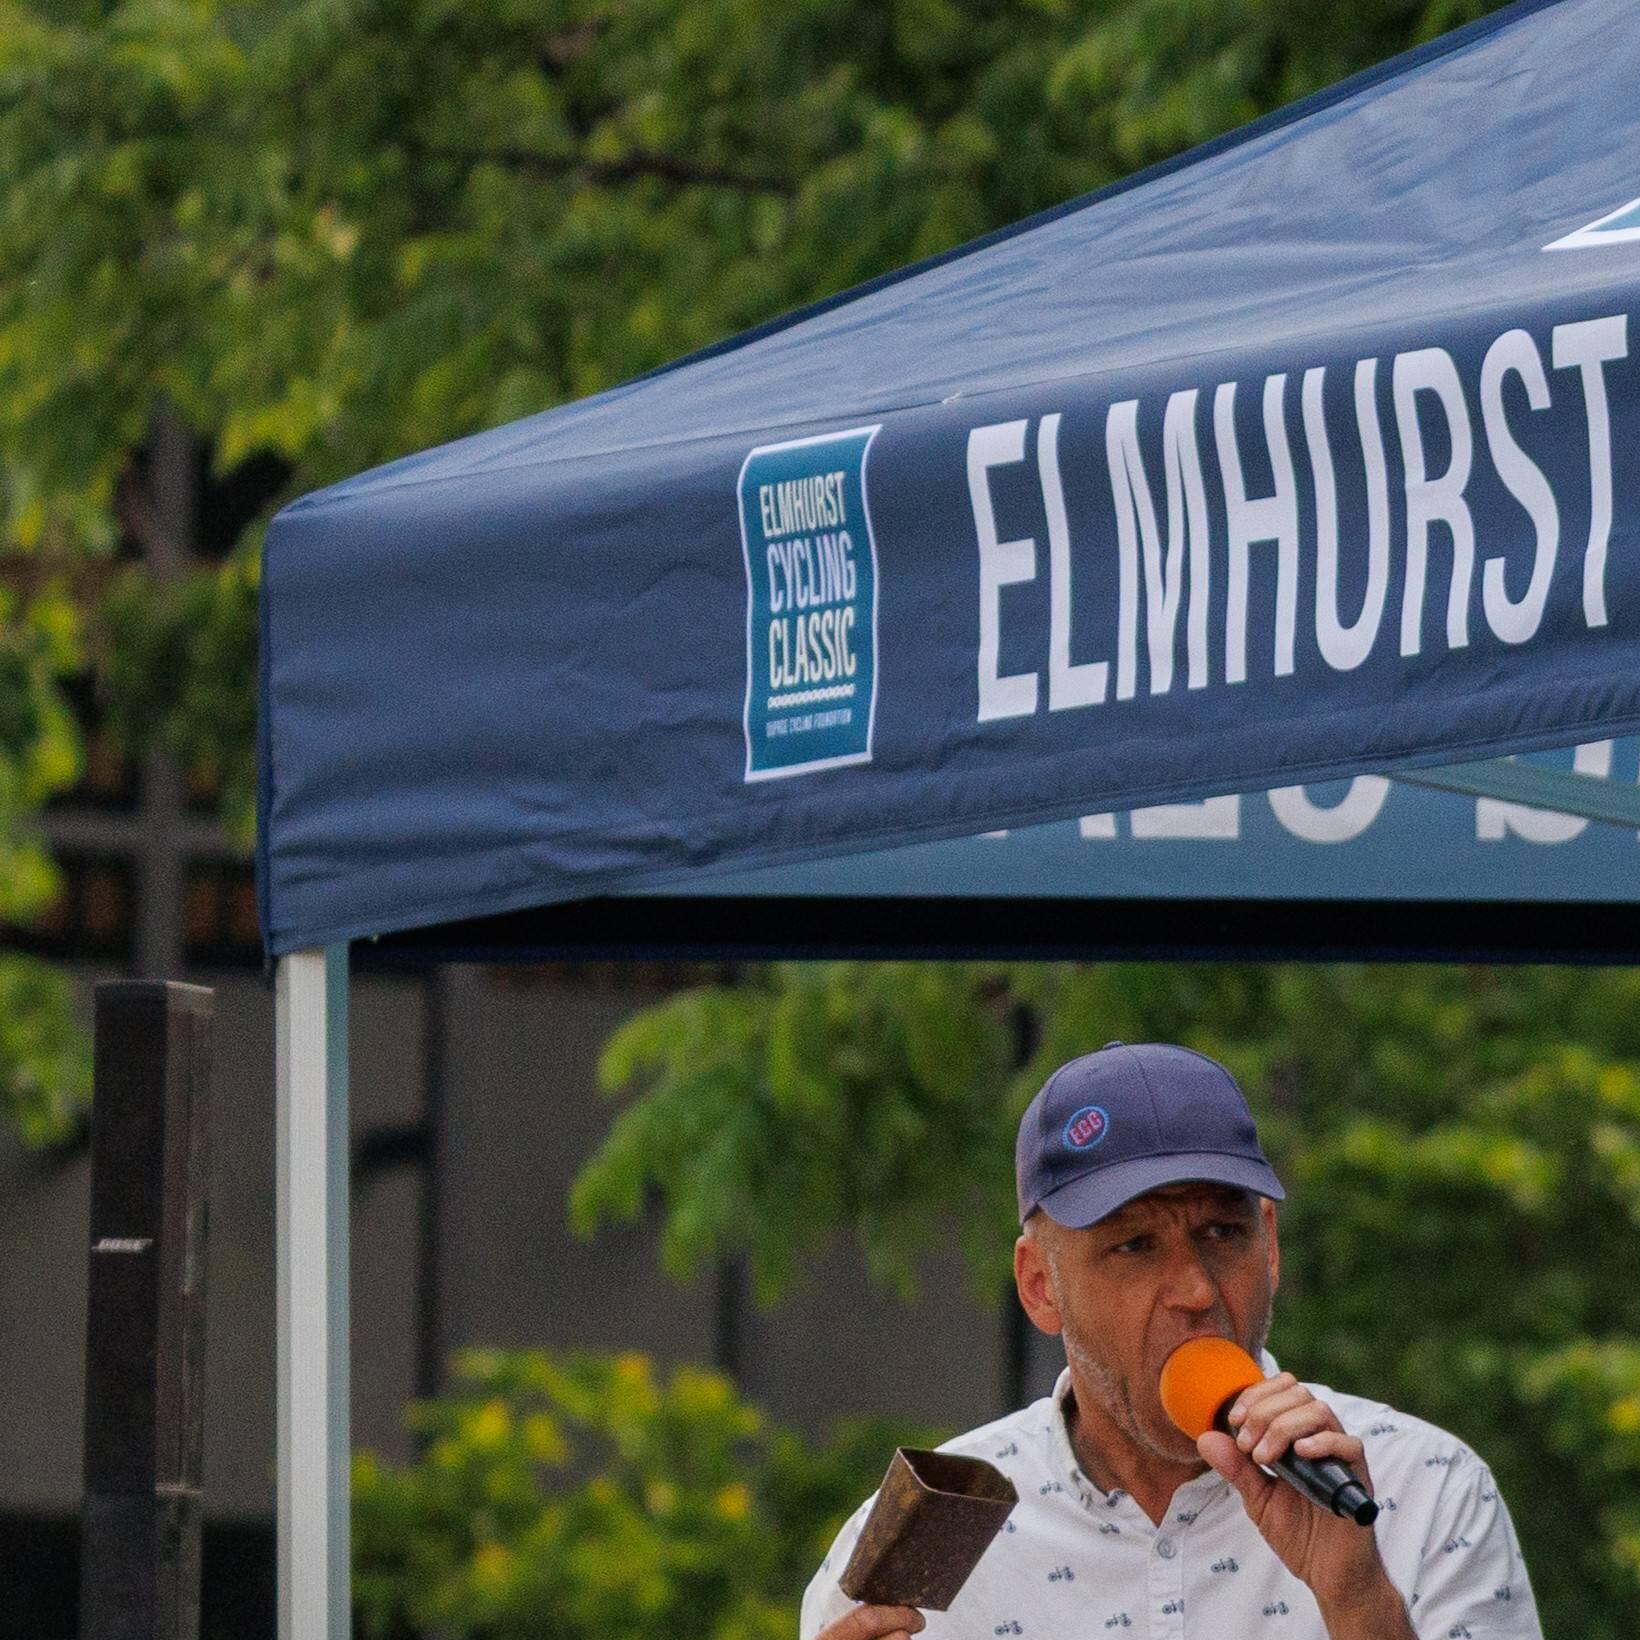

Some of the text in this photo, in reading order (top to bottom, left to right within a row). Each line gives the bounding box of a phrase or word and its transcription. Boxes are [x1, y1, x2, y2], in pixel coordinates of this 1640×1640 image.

[760, 471, 847, 538] ELMHURST
[966, 314, 1628, 724] ELMHURST
[766, 530, 856, 613] CYCLING
[768, 606, 857, 689] CLASSIC
